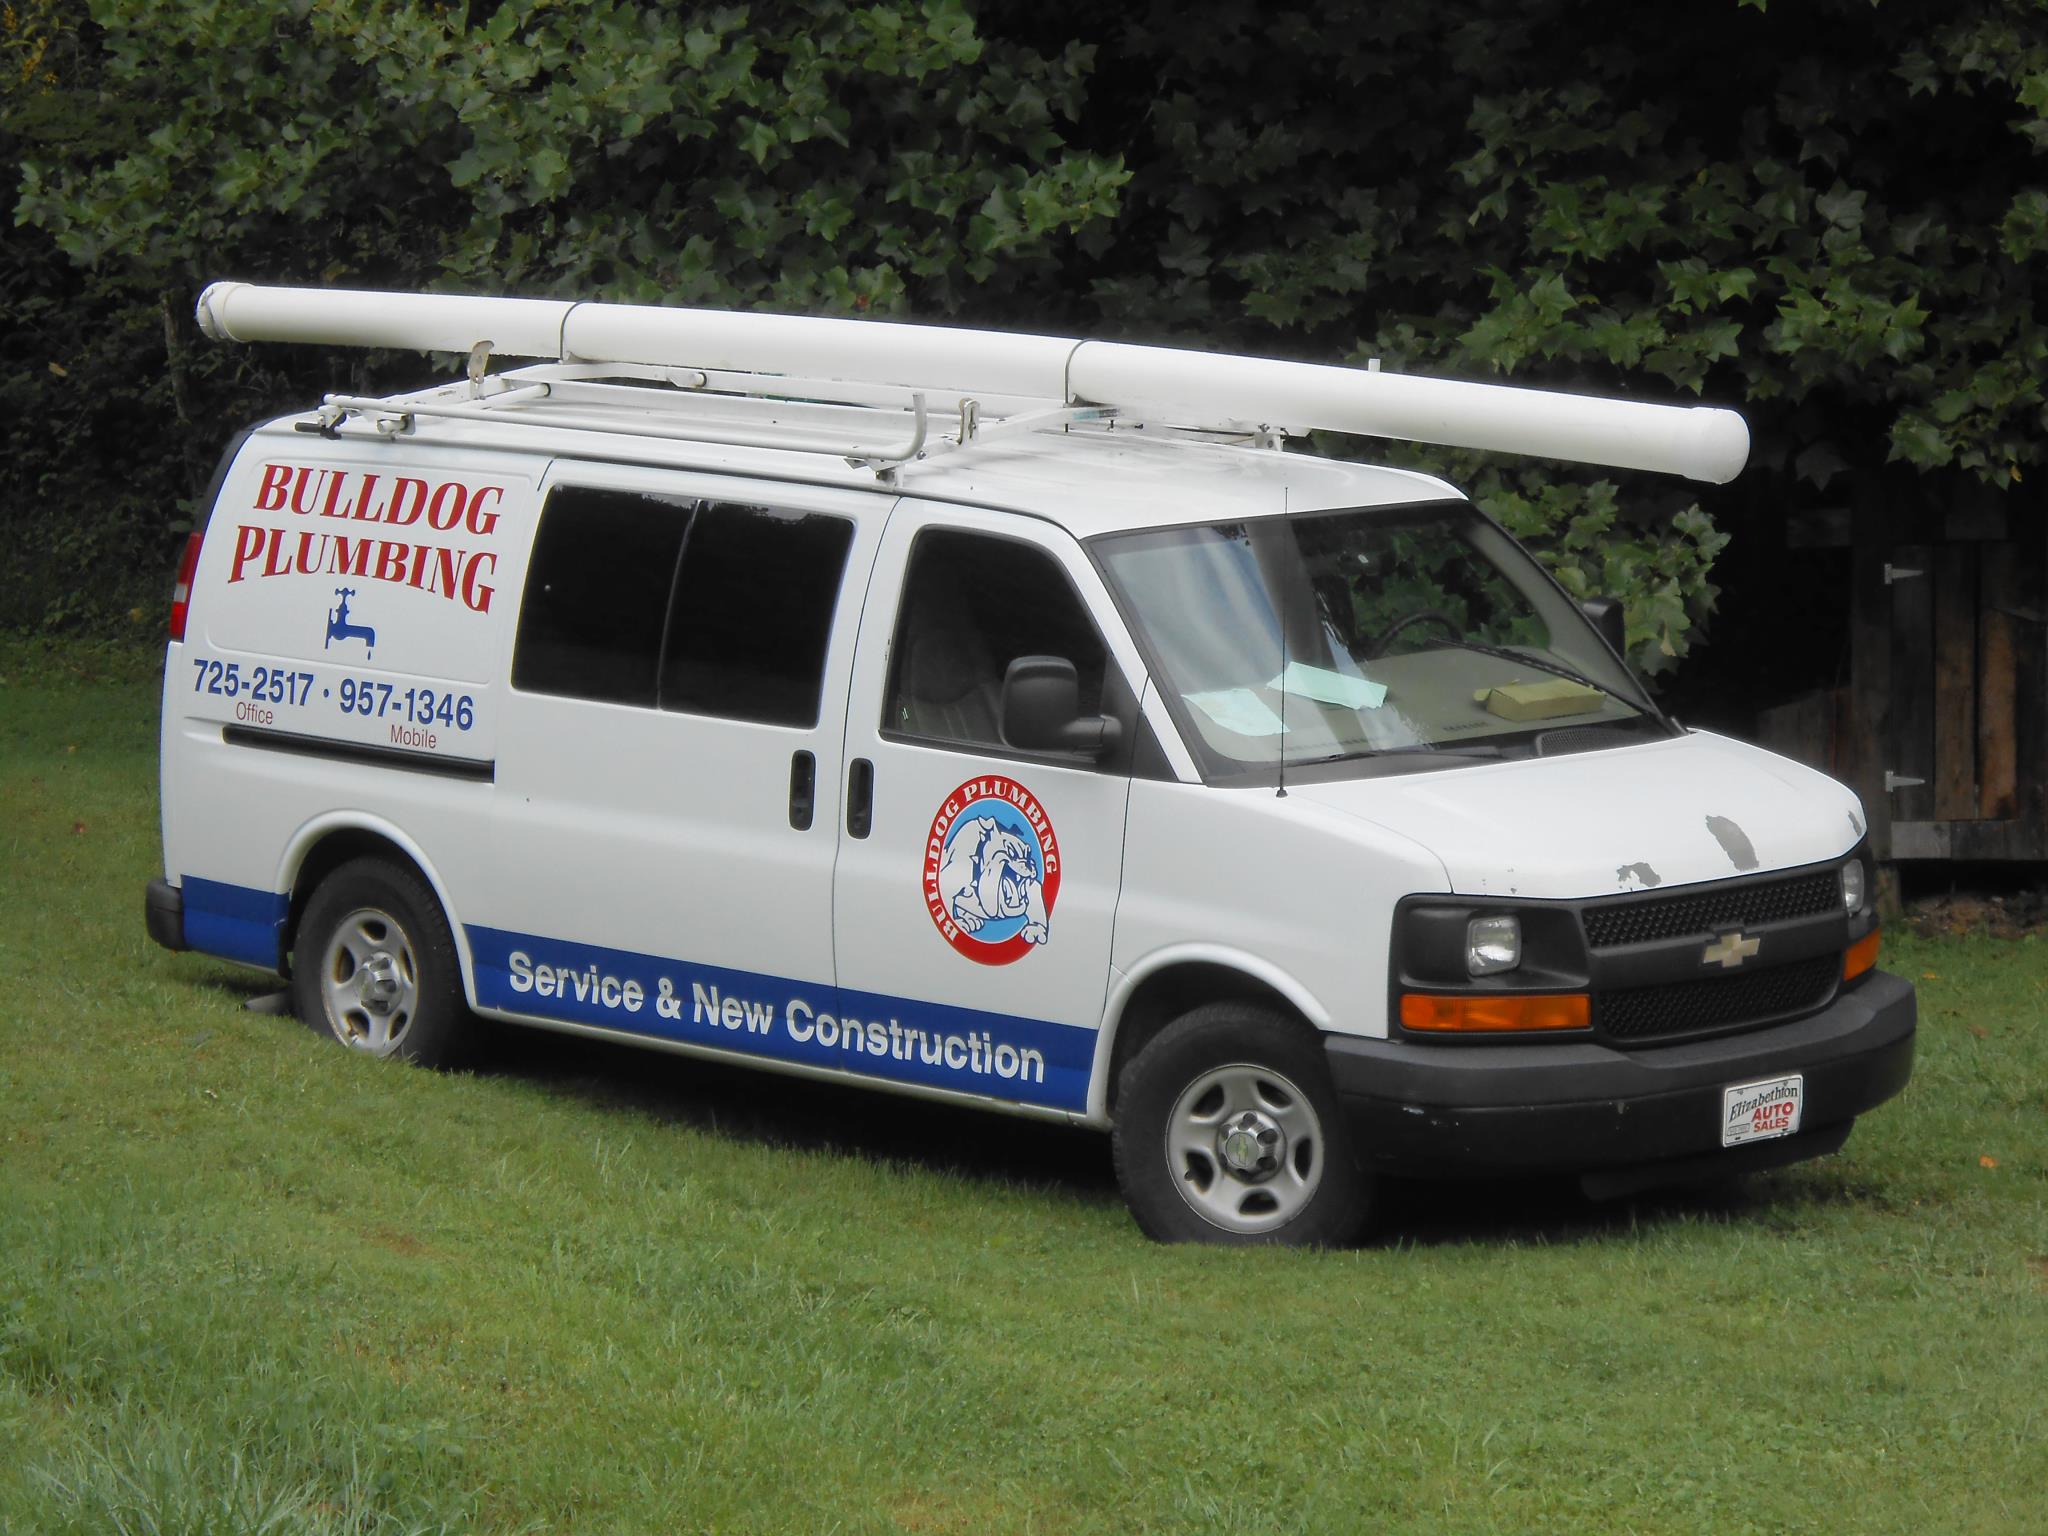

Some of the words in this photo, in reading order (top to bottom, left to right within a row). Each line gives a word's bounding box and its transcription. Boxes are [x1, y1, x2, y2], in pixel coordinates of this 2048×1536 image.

[253, 464, 504, 535] BULLDOG
[228, 525, 498, 615] PLUMBING
[193, 659, 314, 706] 725-2517
[339, 678, 473, 731] 957-1346
[236, 701, 273, 725] Office
[390, 725, 437, 749] Mobile
[926, 799, 960, 942] BULLDOG
[963, 780, 1057, 874] PLUMBING
[509, 951, 644, 1012] Service
[656, 978, 681, 1020] &
[692, 982, 774, 1035] New
[786, 999, 1044, 1084] Construction
[1729, 1087, 1798, 1122] Elizabethton
[1751, 1101, 1794, 1122] AUTO
[1753, 1117, 1789, 1133] SALES
